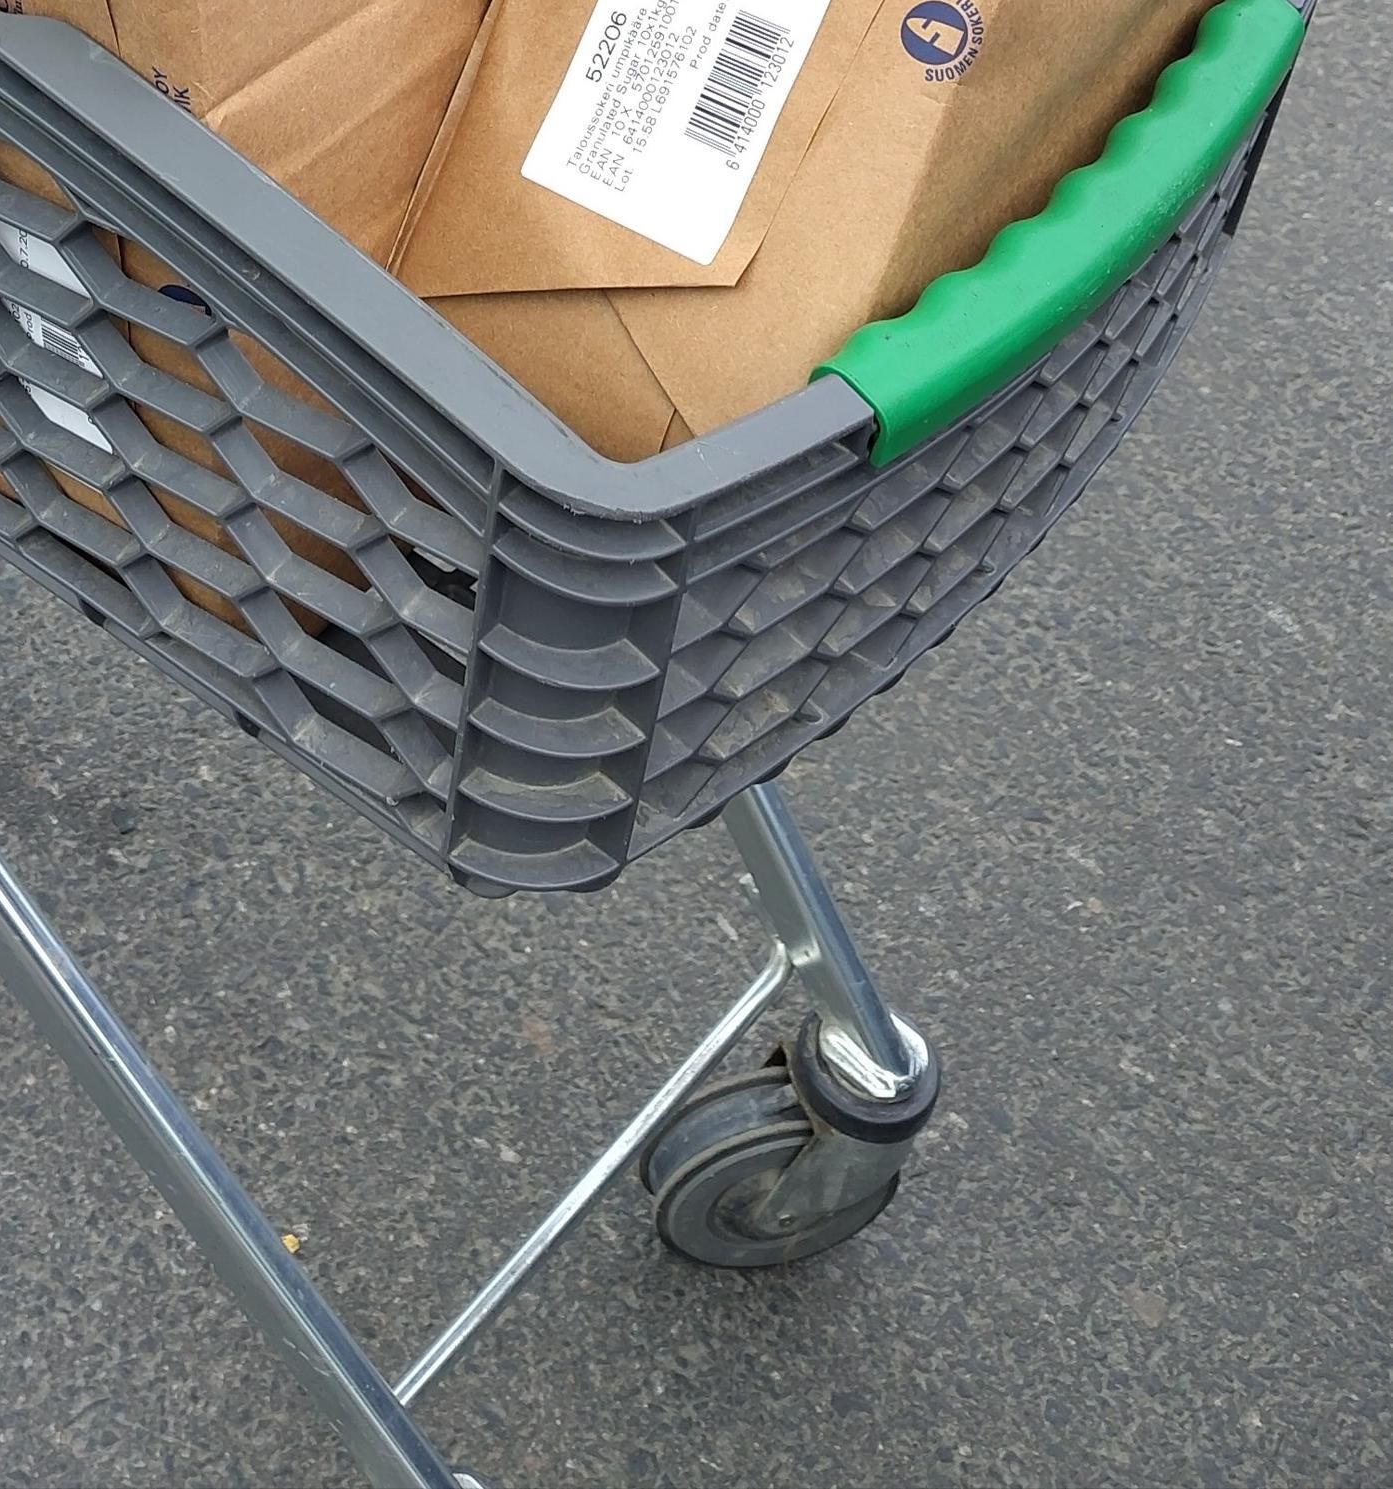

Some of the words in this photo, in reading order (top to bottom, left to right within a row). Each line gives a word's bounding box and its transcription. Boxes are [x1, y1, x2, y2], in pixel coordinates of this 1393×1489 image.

[585, 10, 628, 83] 52206
[689, 35, 712, 70] Prod
[924, 45, 979, 84] SUOMEN
[151, 66, 169, 95] OY
[578, 97, 623, 175] Granulated
[616, 54, 643, 96] Sugar
[637, 0, 669, 47] 10x1kg
[602, 153, 626, 188] EAN
[622, 31, 681, 146] 6414000123012
[725, 158, 741, 172] 6
[733, 98, 767, 155] 414000
[760, 35, 795, 90] 123012
[590, 148, 614, 181] EAN
[611, 120, 626, 137] 10
